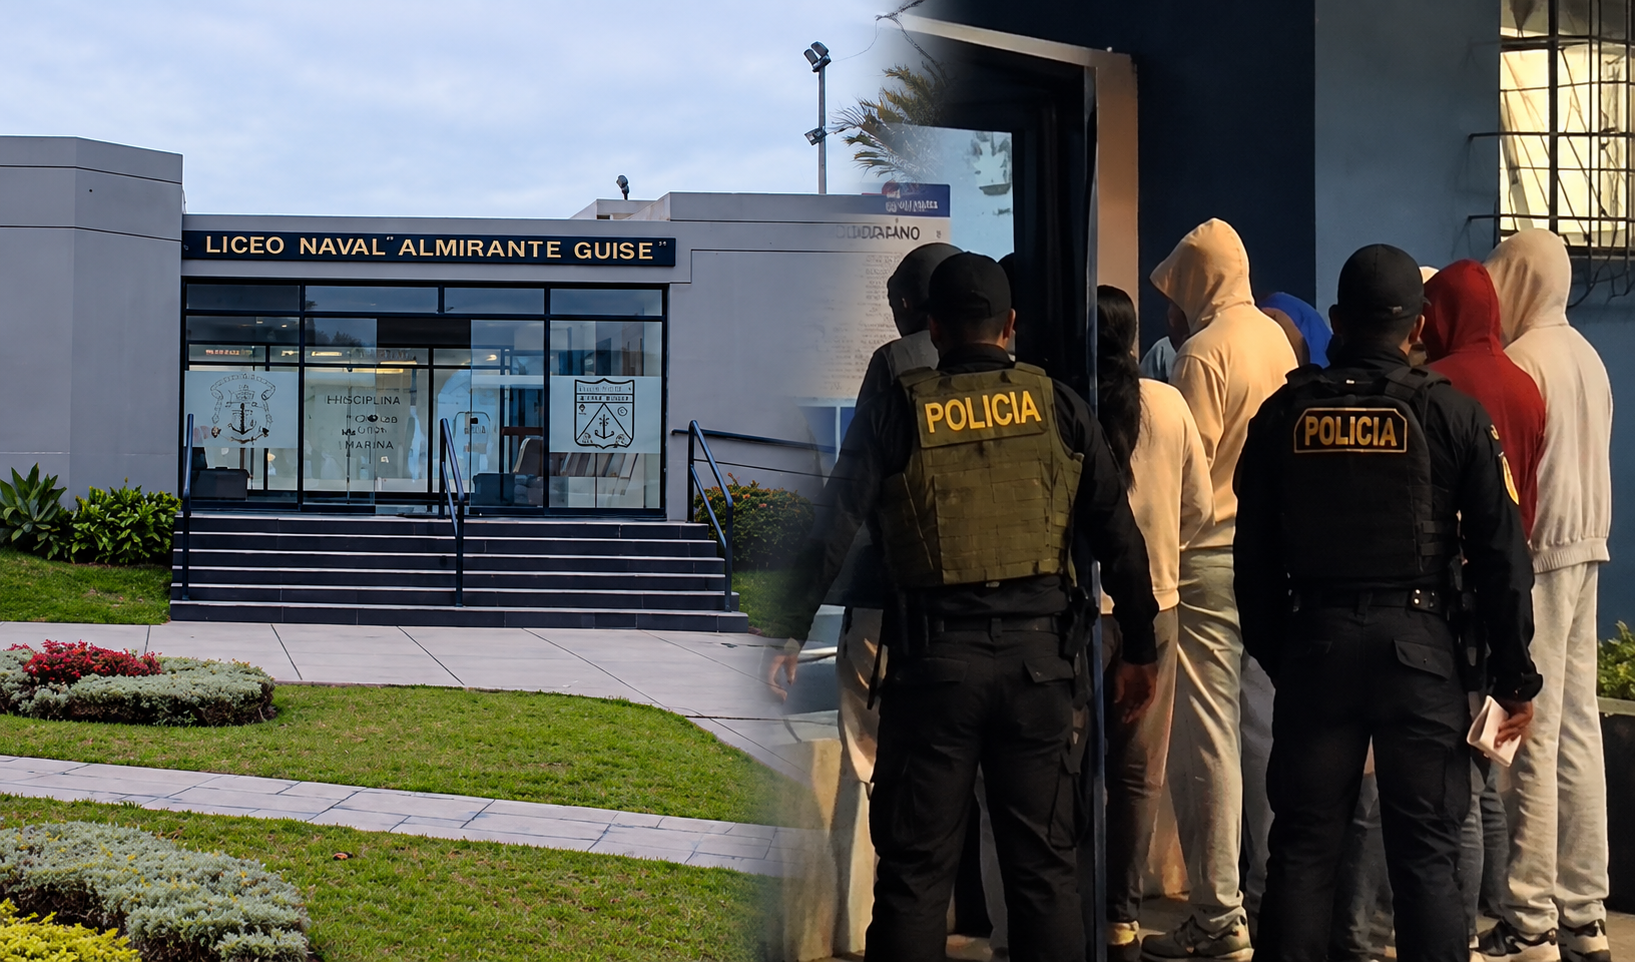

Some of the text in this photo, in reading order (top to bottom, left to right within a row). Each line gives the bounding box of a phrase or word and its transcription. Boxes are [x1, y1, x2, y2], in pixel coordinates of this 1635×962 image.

[205, 235, 285, 254] LICEO
[300, 237, 386, 255] NAVAL
[924, 390, 1042, 433] POLICIA
[1304, 415, 1398, 446] POLICIA
[345, 440, 394, 450] MARINA
